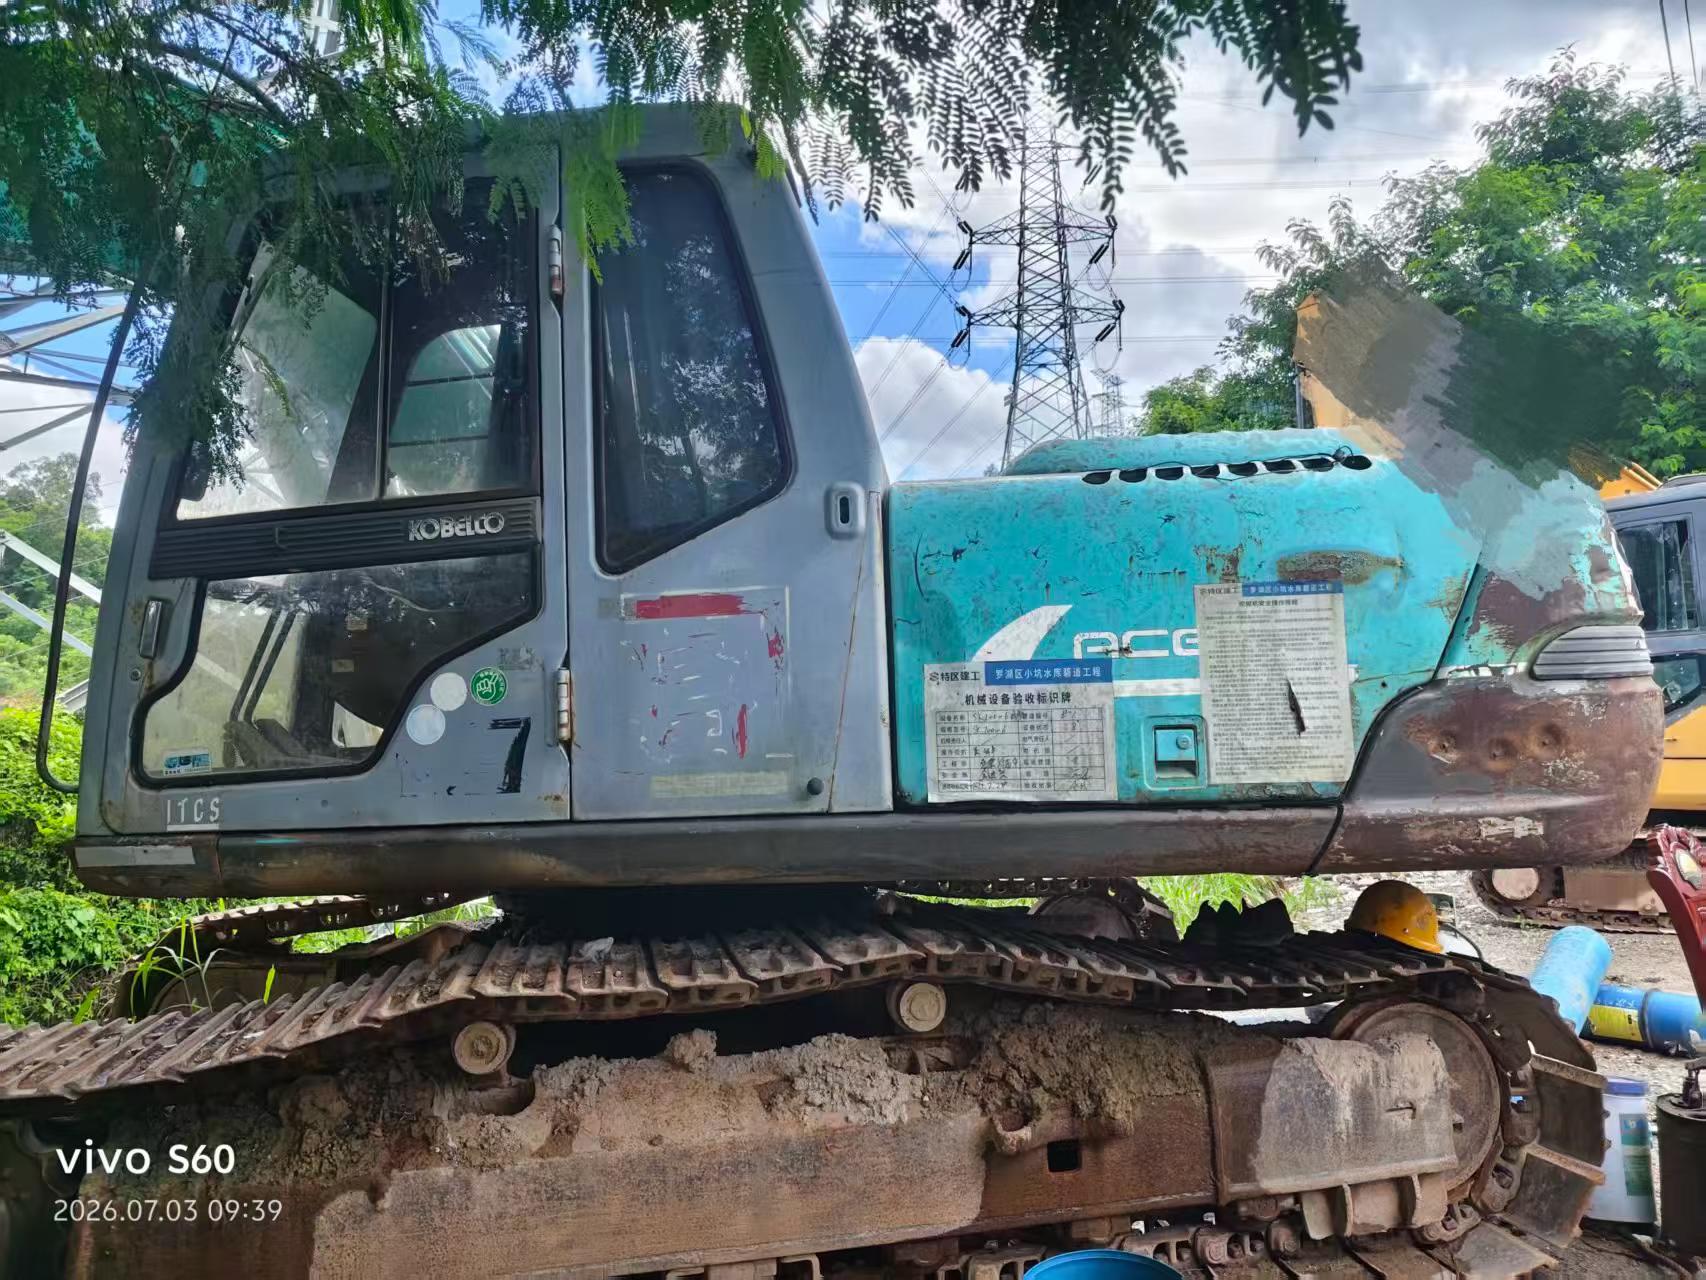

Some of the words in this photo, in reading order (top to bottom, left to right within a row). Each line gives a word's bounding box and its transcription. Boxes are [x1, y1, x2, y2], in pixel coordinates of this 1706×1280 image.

[408, 512, 504, 541] KOBELCO
[940, 671, 980, 681] 特区建工
[995, 666, 1101, 680] 罗湖区小坑水库碧道工程
[965, 691, 1072, 706] 机械设备验收标识牌
